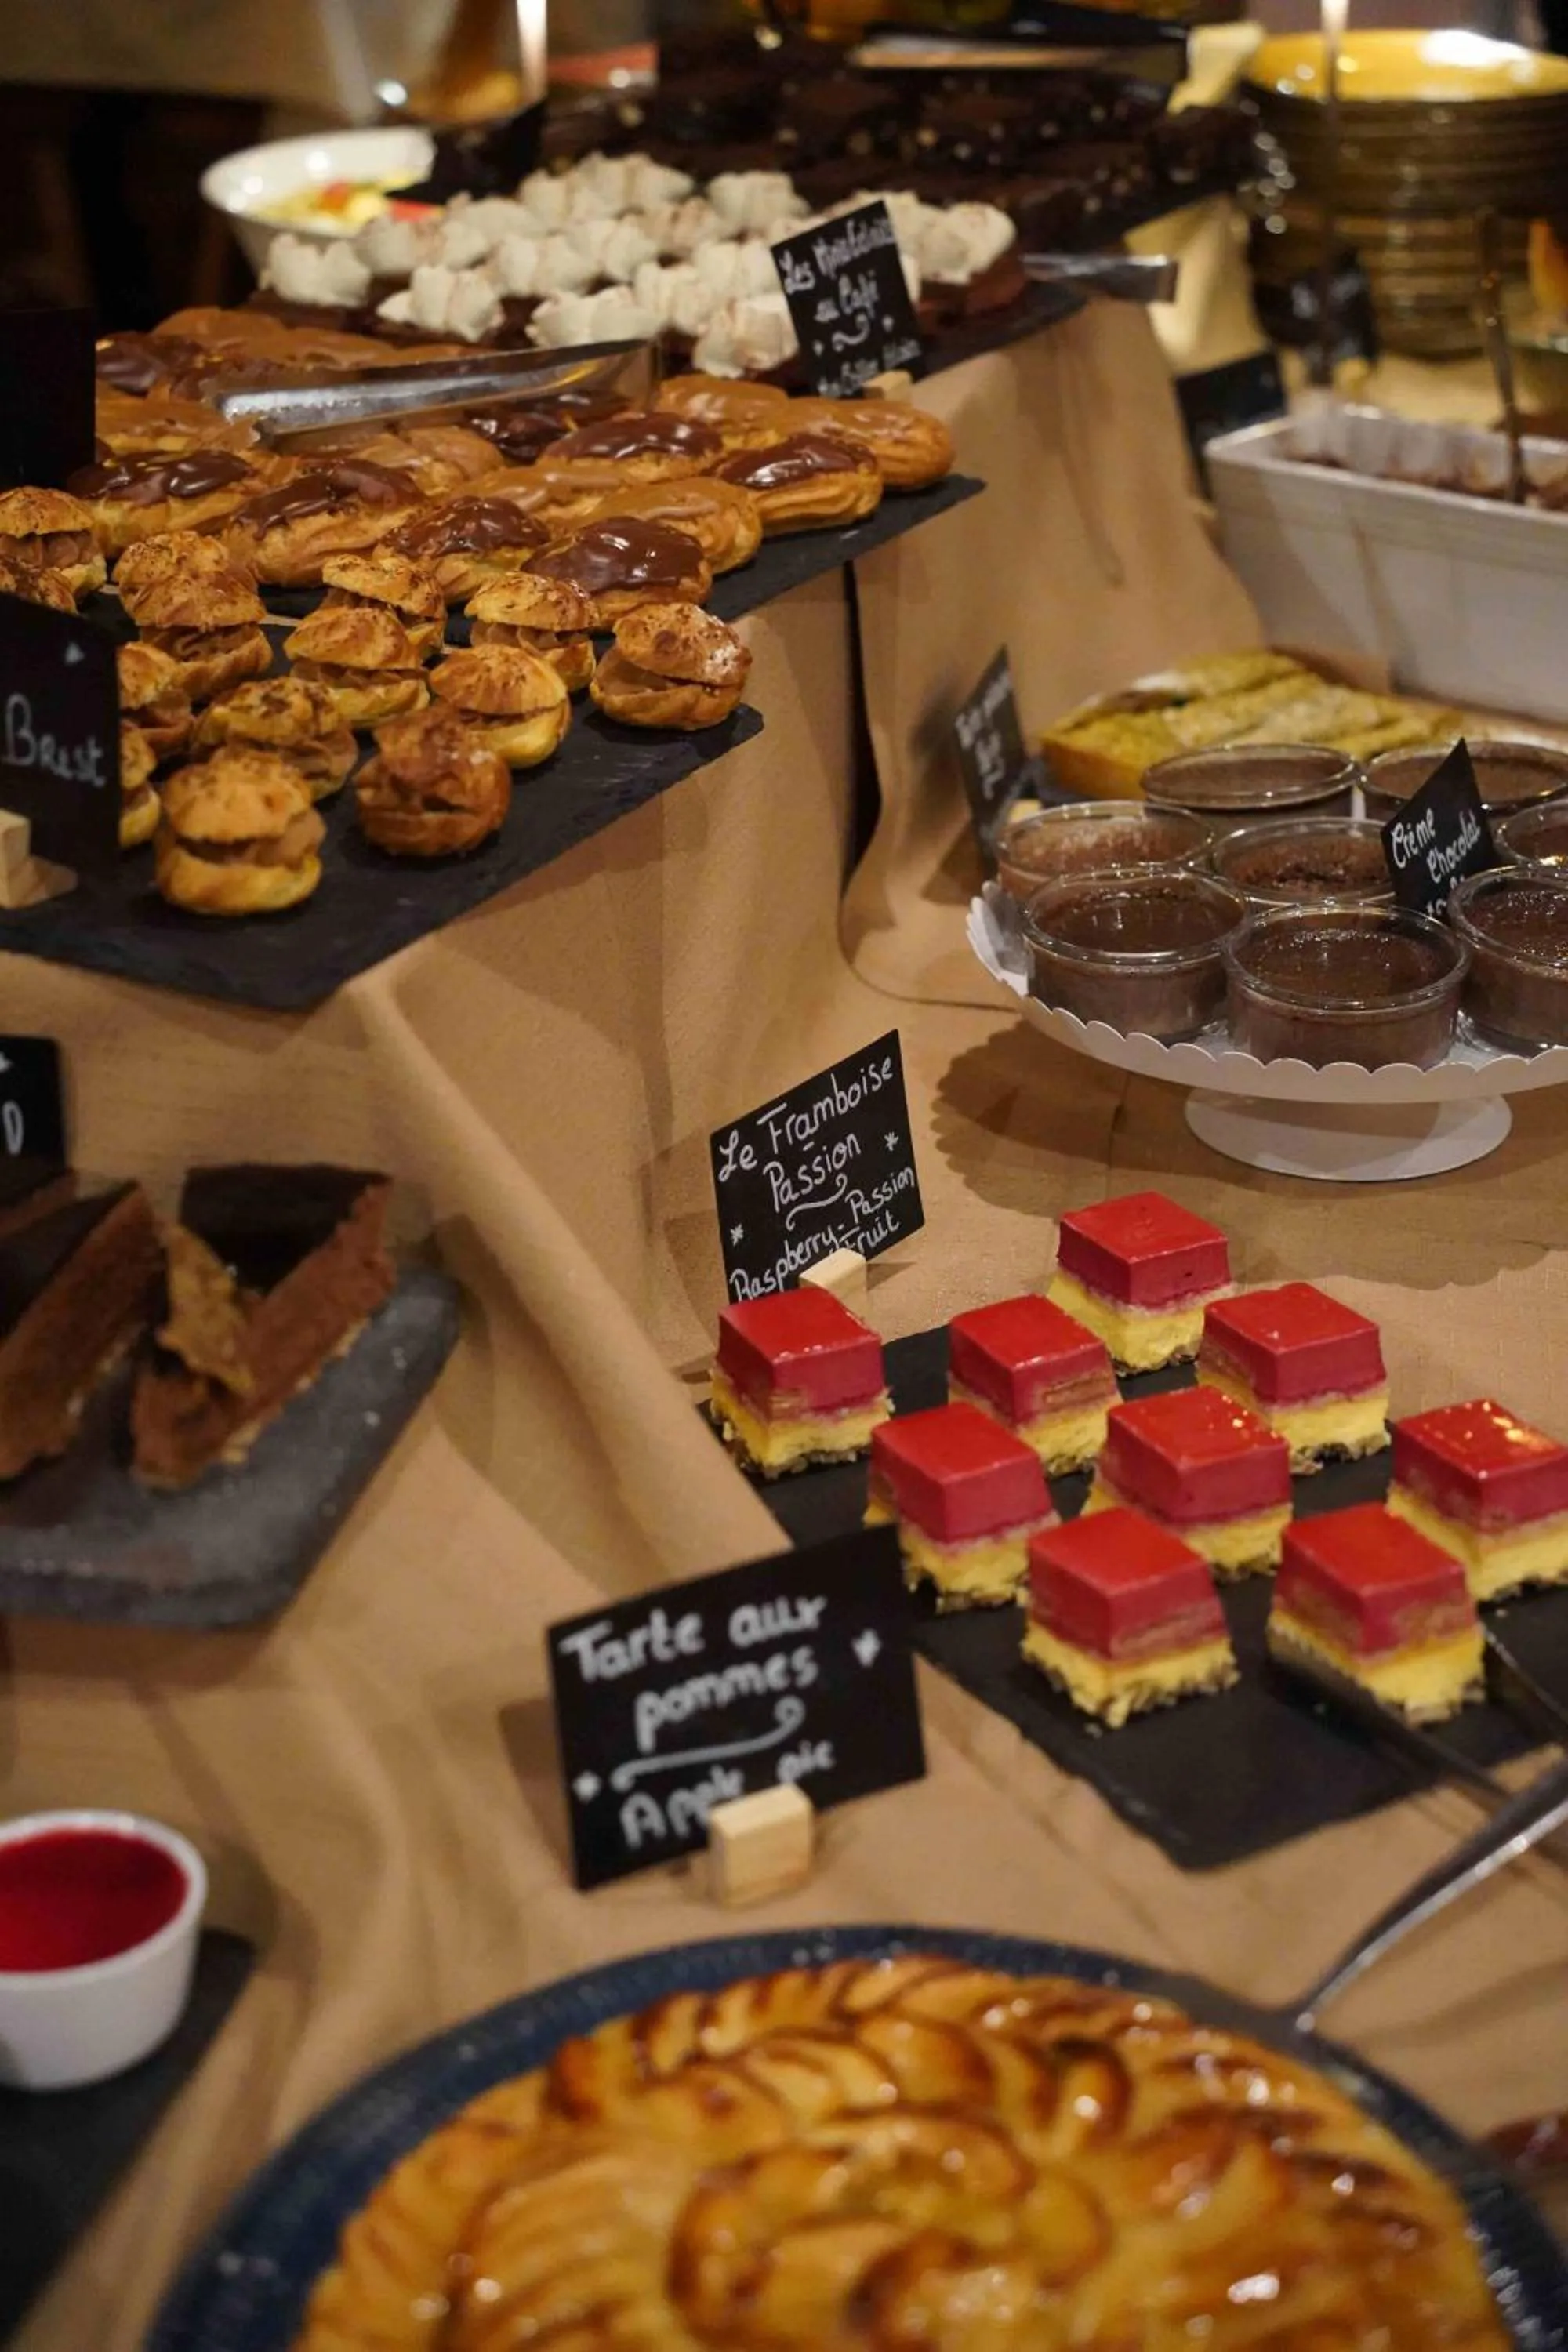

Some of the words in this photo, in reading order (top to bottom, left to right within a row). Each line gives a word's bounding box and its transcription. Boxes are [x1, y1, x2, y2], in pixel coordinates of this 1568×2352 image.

[4, 693, 106, 788] Brest
[718, 1128, 758, 1182] Le
[757, 1058, 893, 1155] Framboise
[763, 1134, 861, 1214] Passion
[558, 1607, 706, 1682] Tarte
[728, 1595, 826, 1647] aux
[633, 1645, 818, 1754] pommes
